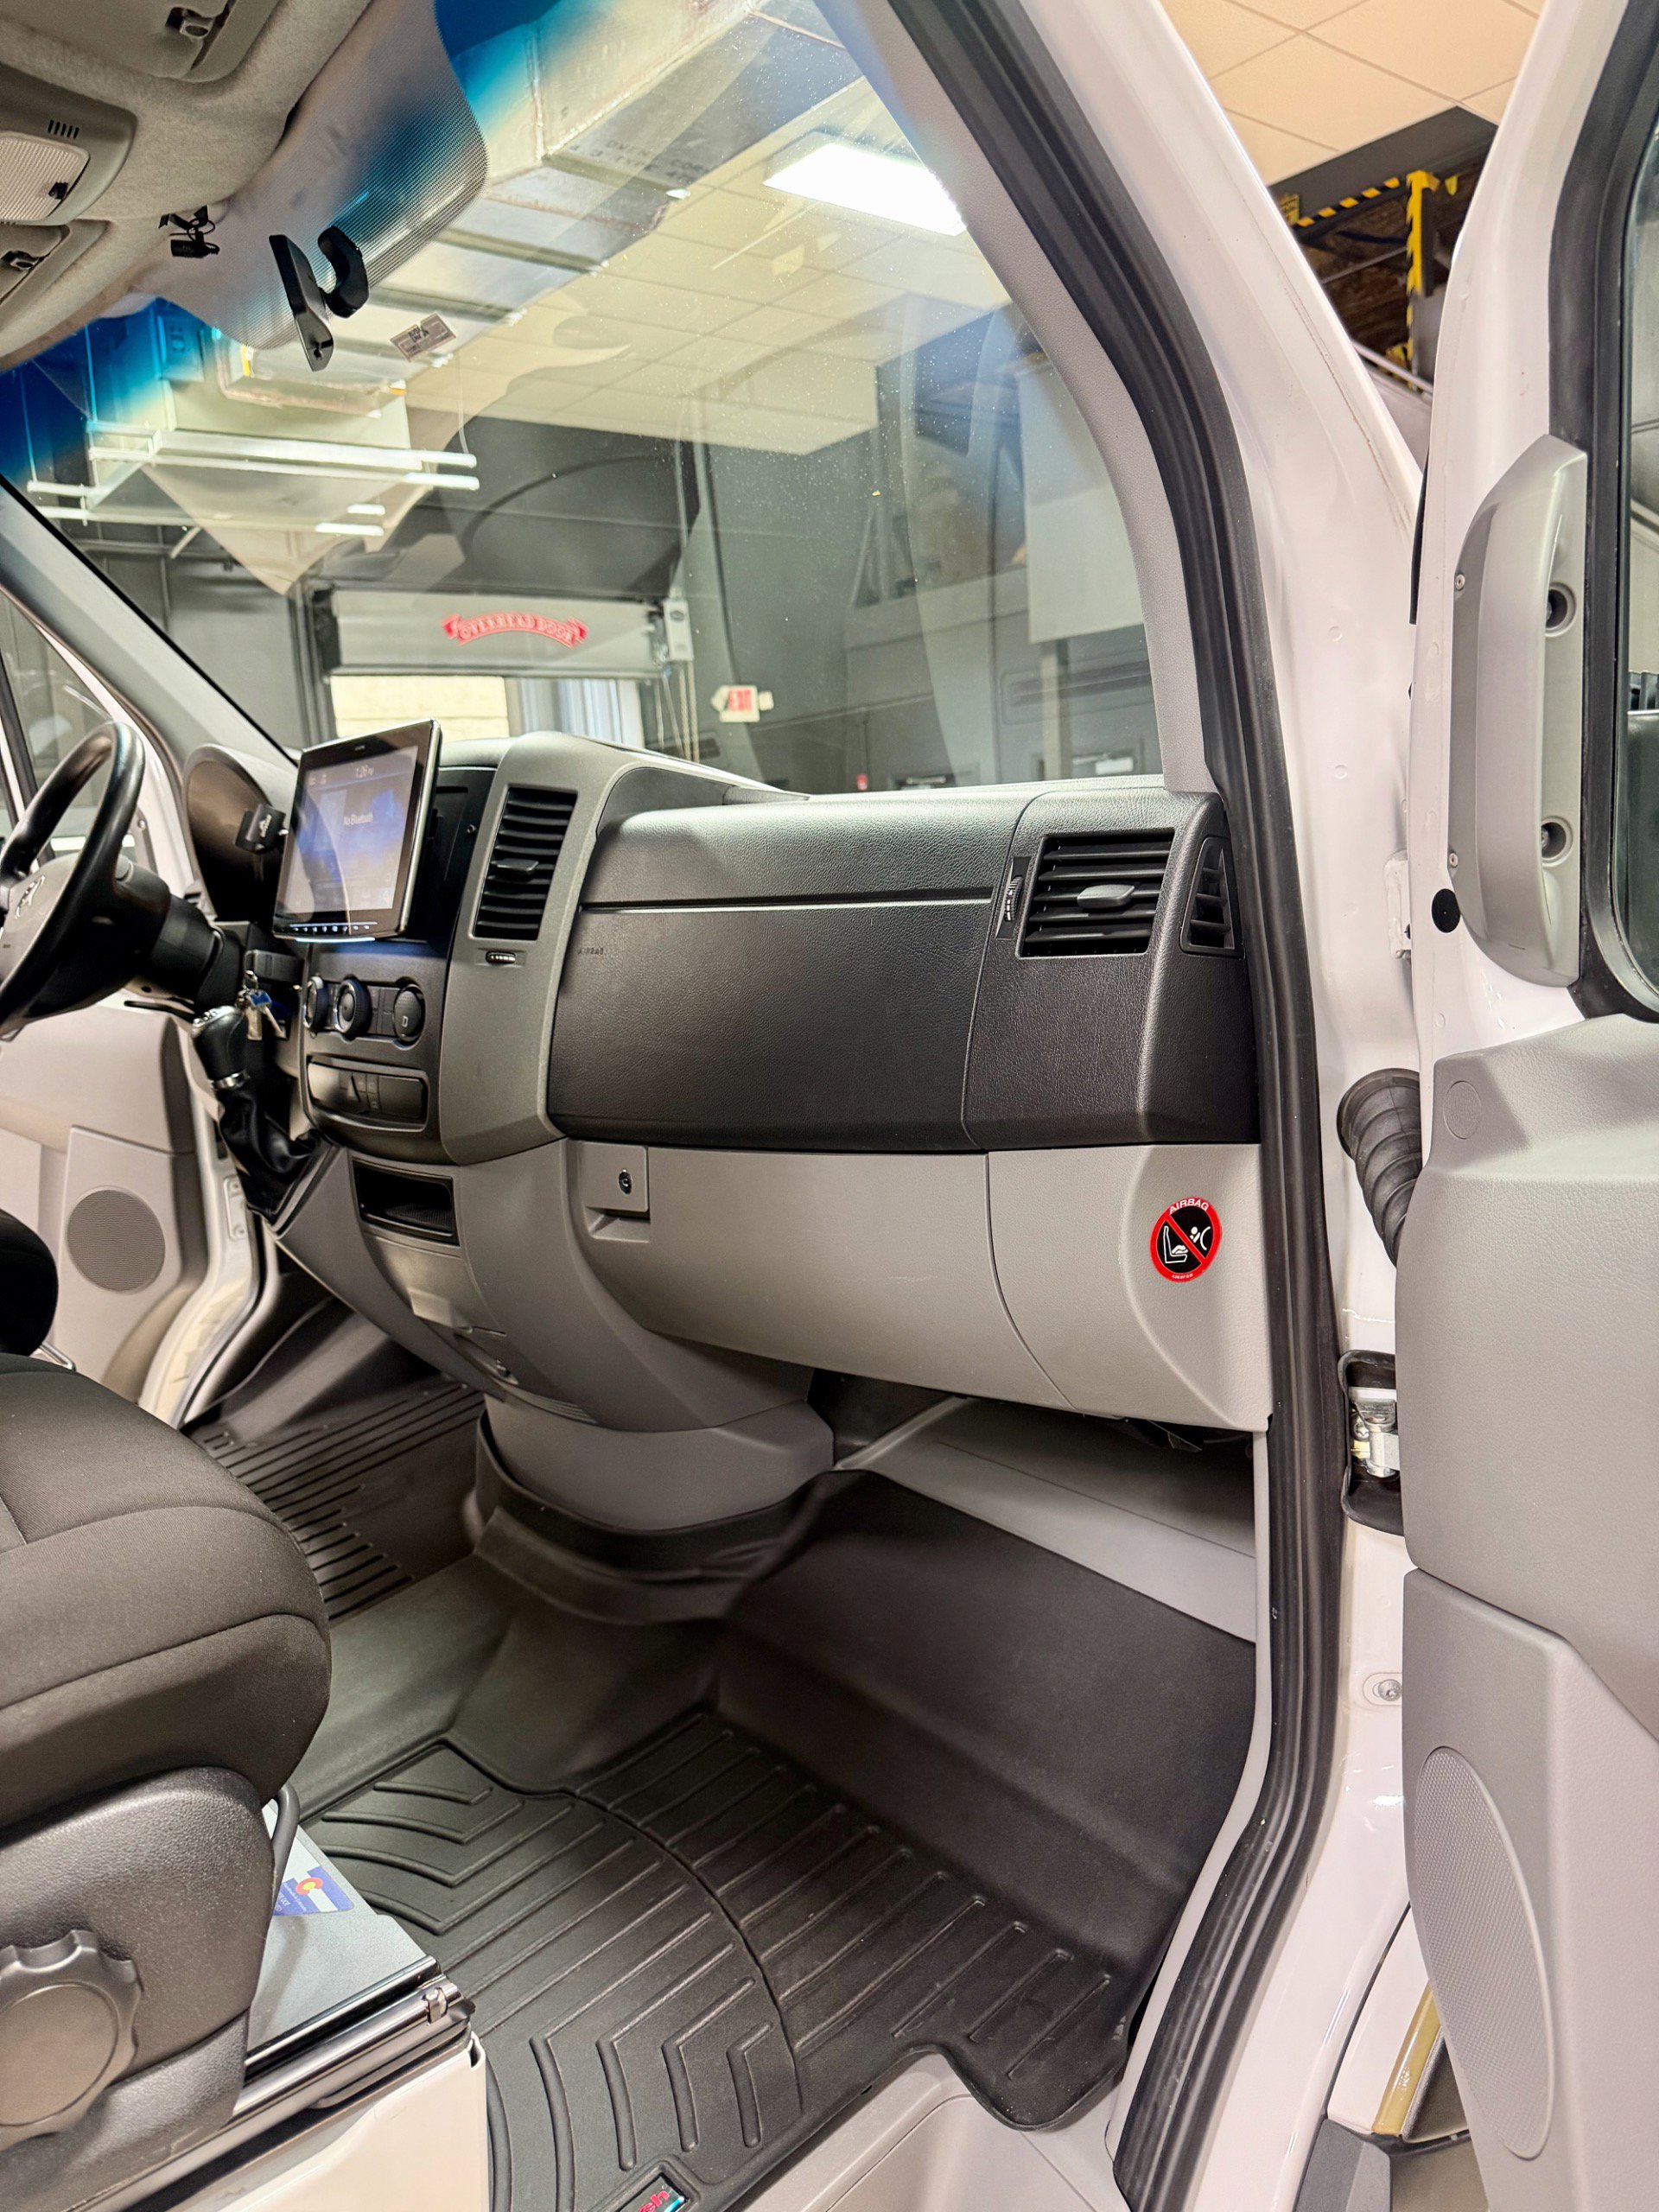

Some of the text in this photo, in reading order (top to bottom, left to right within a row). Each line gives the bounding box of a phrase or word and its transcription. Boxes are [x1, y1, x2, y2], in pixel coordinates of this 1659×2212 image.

[459, 614, 574, 642] OVERHEAD DOOR
[1169, 1198, 1210, 1214] AIRBAG
